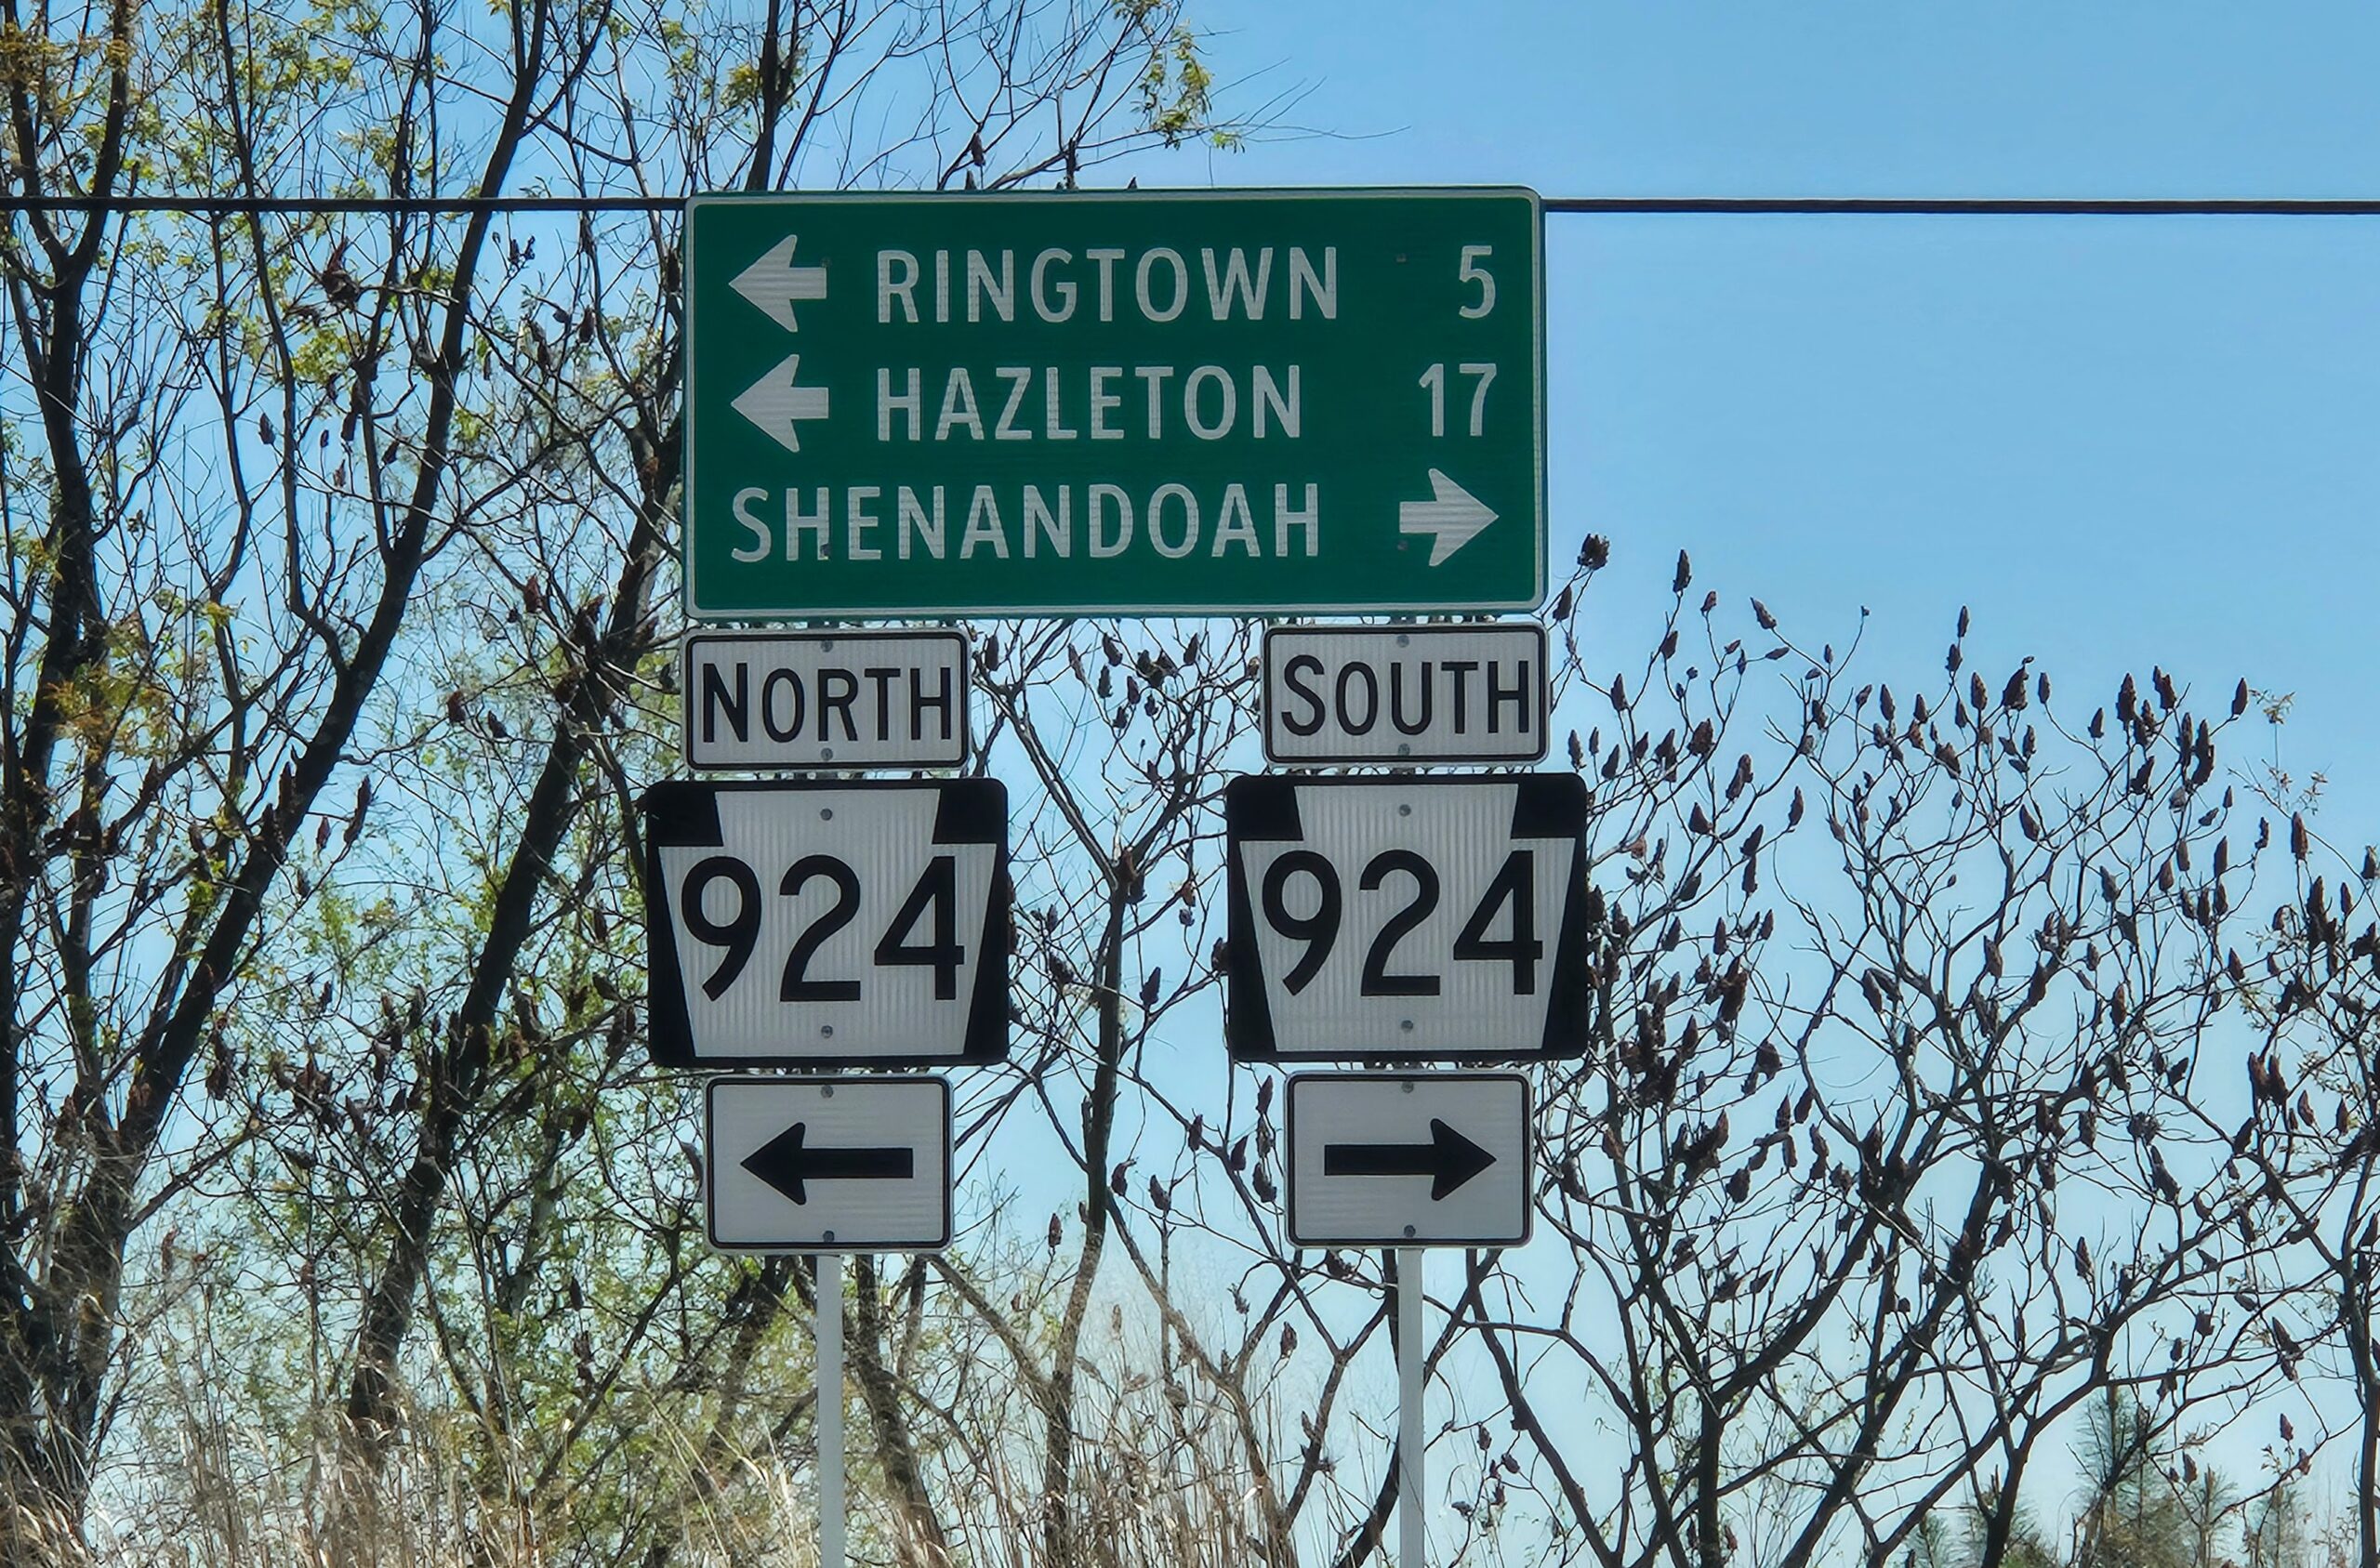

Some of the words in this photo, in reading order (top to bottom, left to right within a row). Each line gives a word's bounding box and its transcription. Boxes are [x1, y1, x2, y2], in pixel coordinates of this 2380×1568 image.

[878, 247, 1336, 323] RINGTOWN
[1460, 245, 1495, 318] 5
[878, 365, 1300, 441] HAZLETON
[1420, 363, 1496, 436] 17
[732, 483, 1318, 562] SHENANDOAH
[703, 663, 951, 743] NORTH
[1281, 655, 1528, 736] SOUTH
[681, 855, 964, 1002] 924
[1263, 850, 1542, 996] 924
